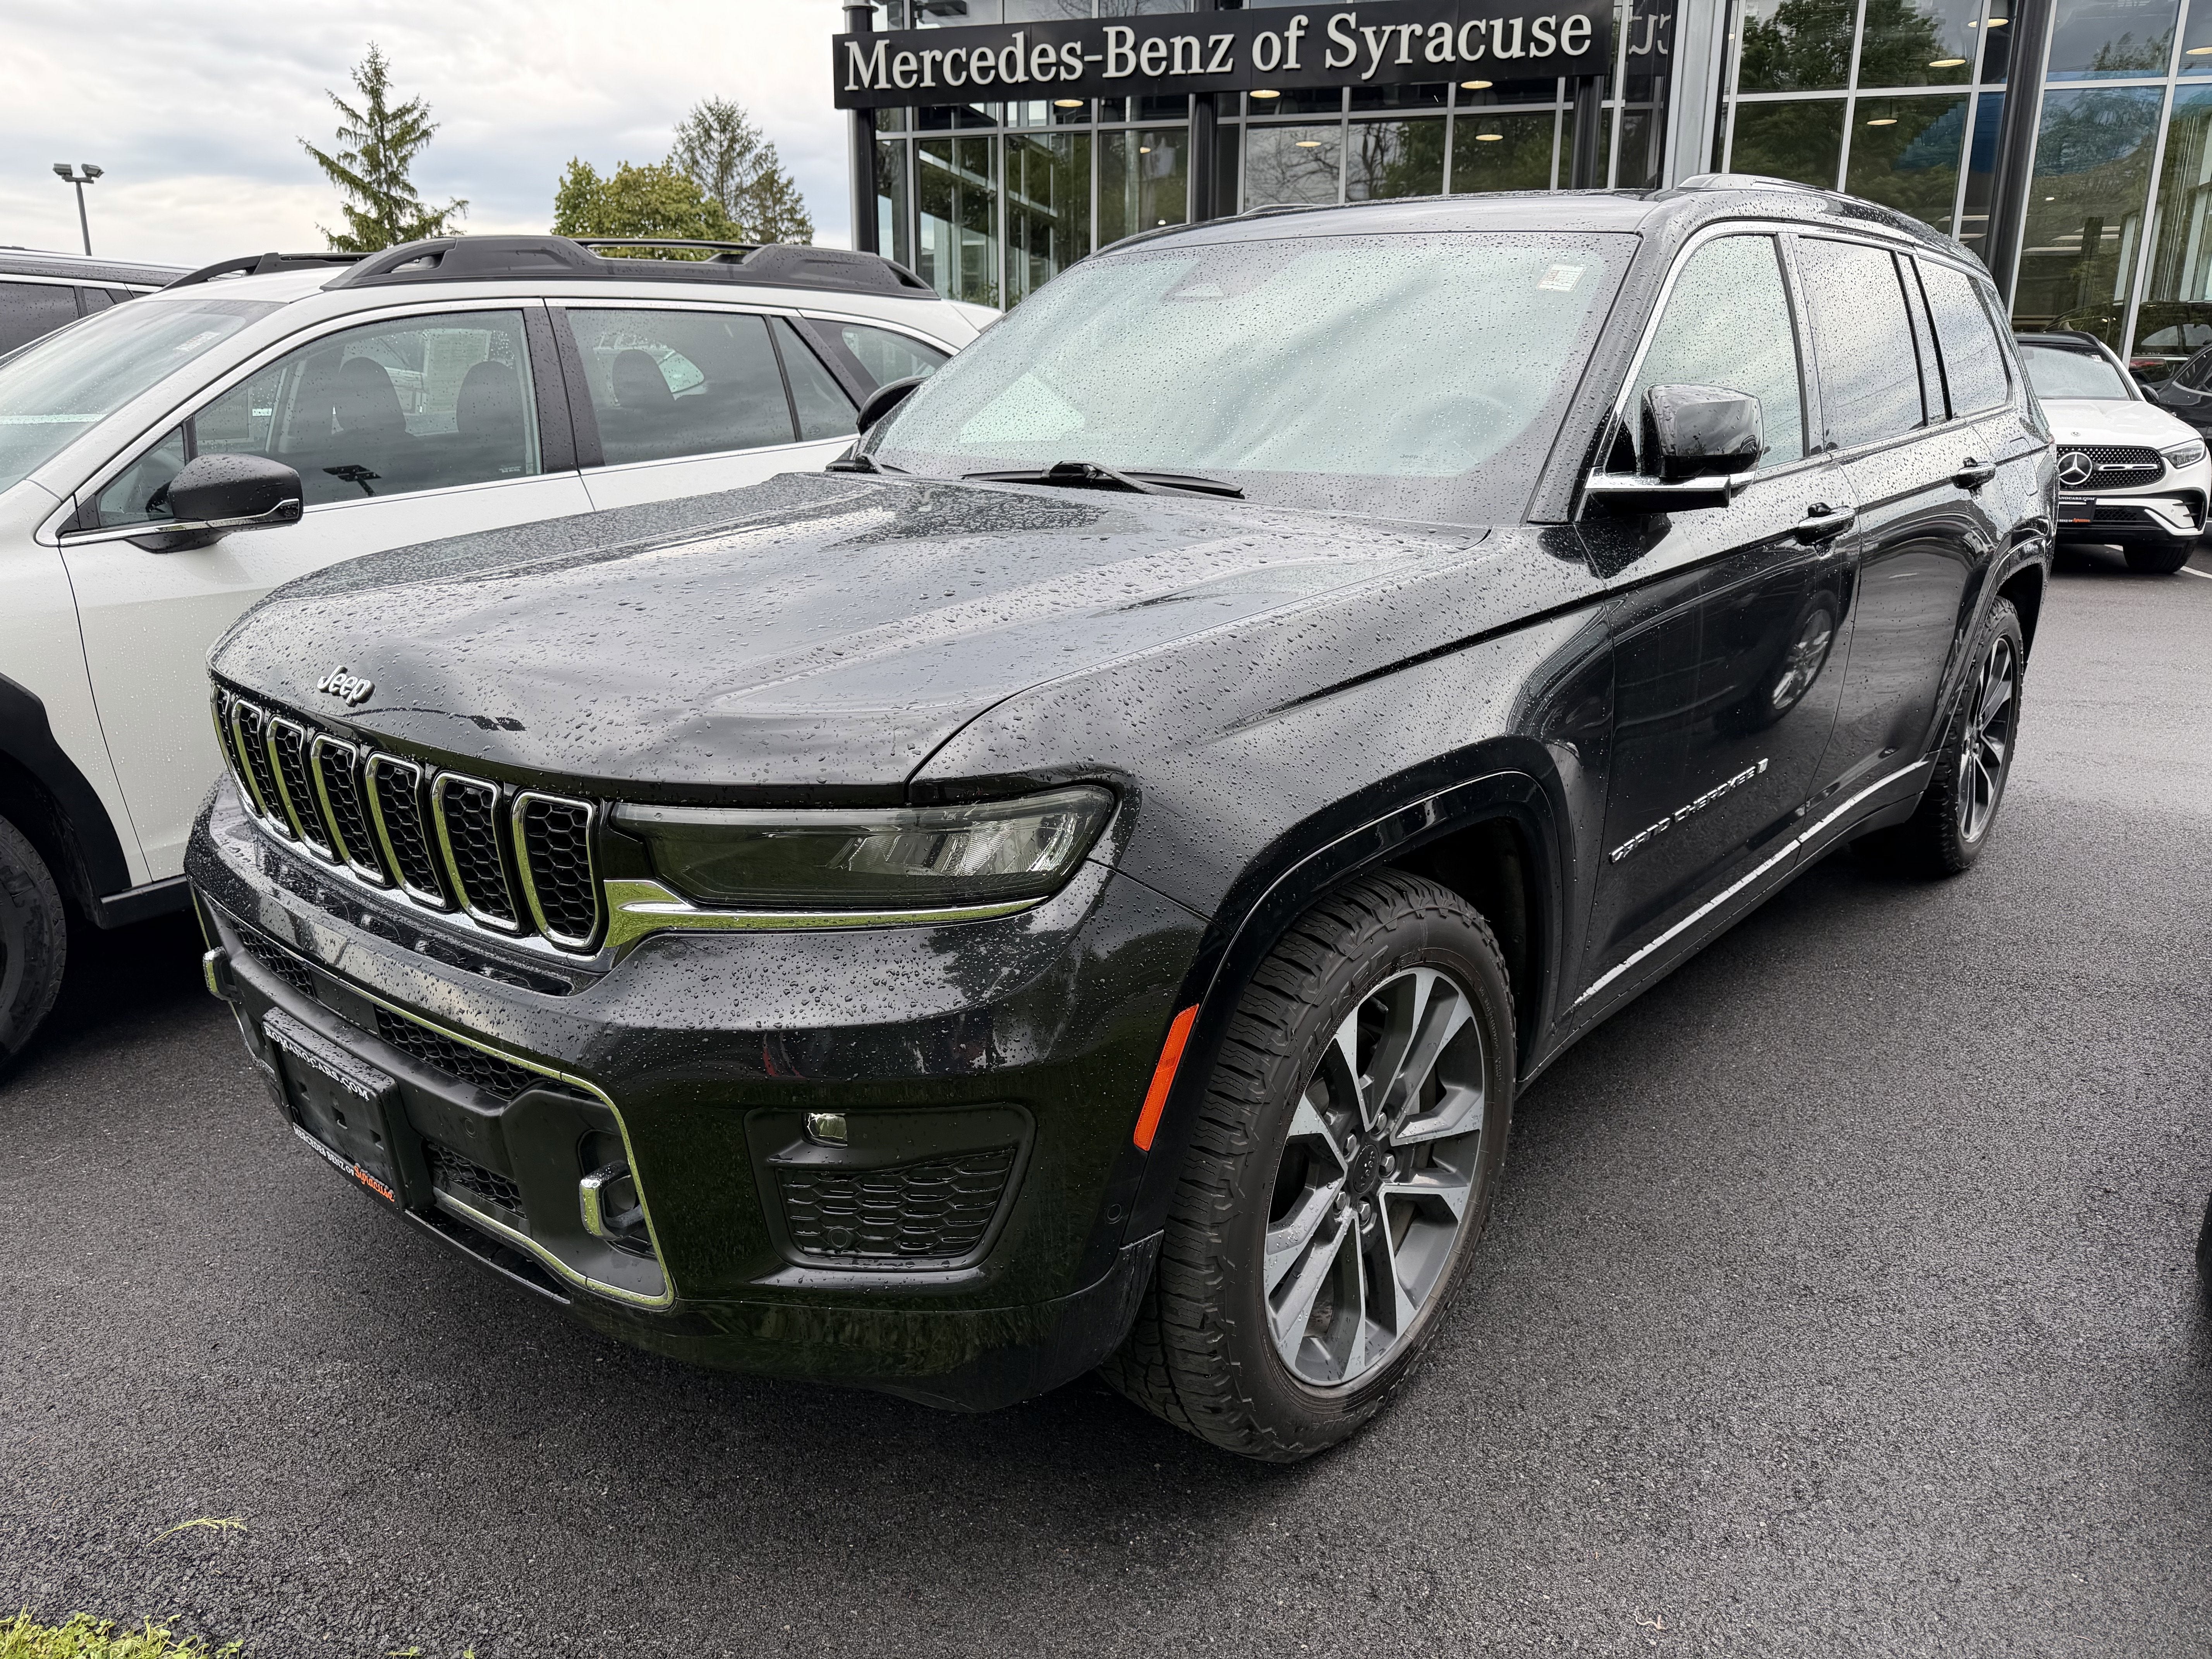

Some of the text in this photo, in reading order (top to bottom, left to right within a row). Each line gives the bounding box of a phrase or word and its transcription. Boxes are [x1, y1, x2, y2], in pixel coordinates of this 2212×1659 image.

[844, 26, 1235, 91] Mercedes-Benz
[1252, 15, 1309, 71] of
[1325, 12, 1592, 80] Syracuse
[317, 665, 376, 708] Jeep
[1609, 766, 1756, 862] GRAND CHEROKEE
[264, 1026, 370, 1102] ROMANOCARS.COM
[293, 1125, 327, 1157] MERCEDES
[326, 1151, 345, 1171] BENZ
[353, 1163, 396, 1202] Syracuse
